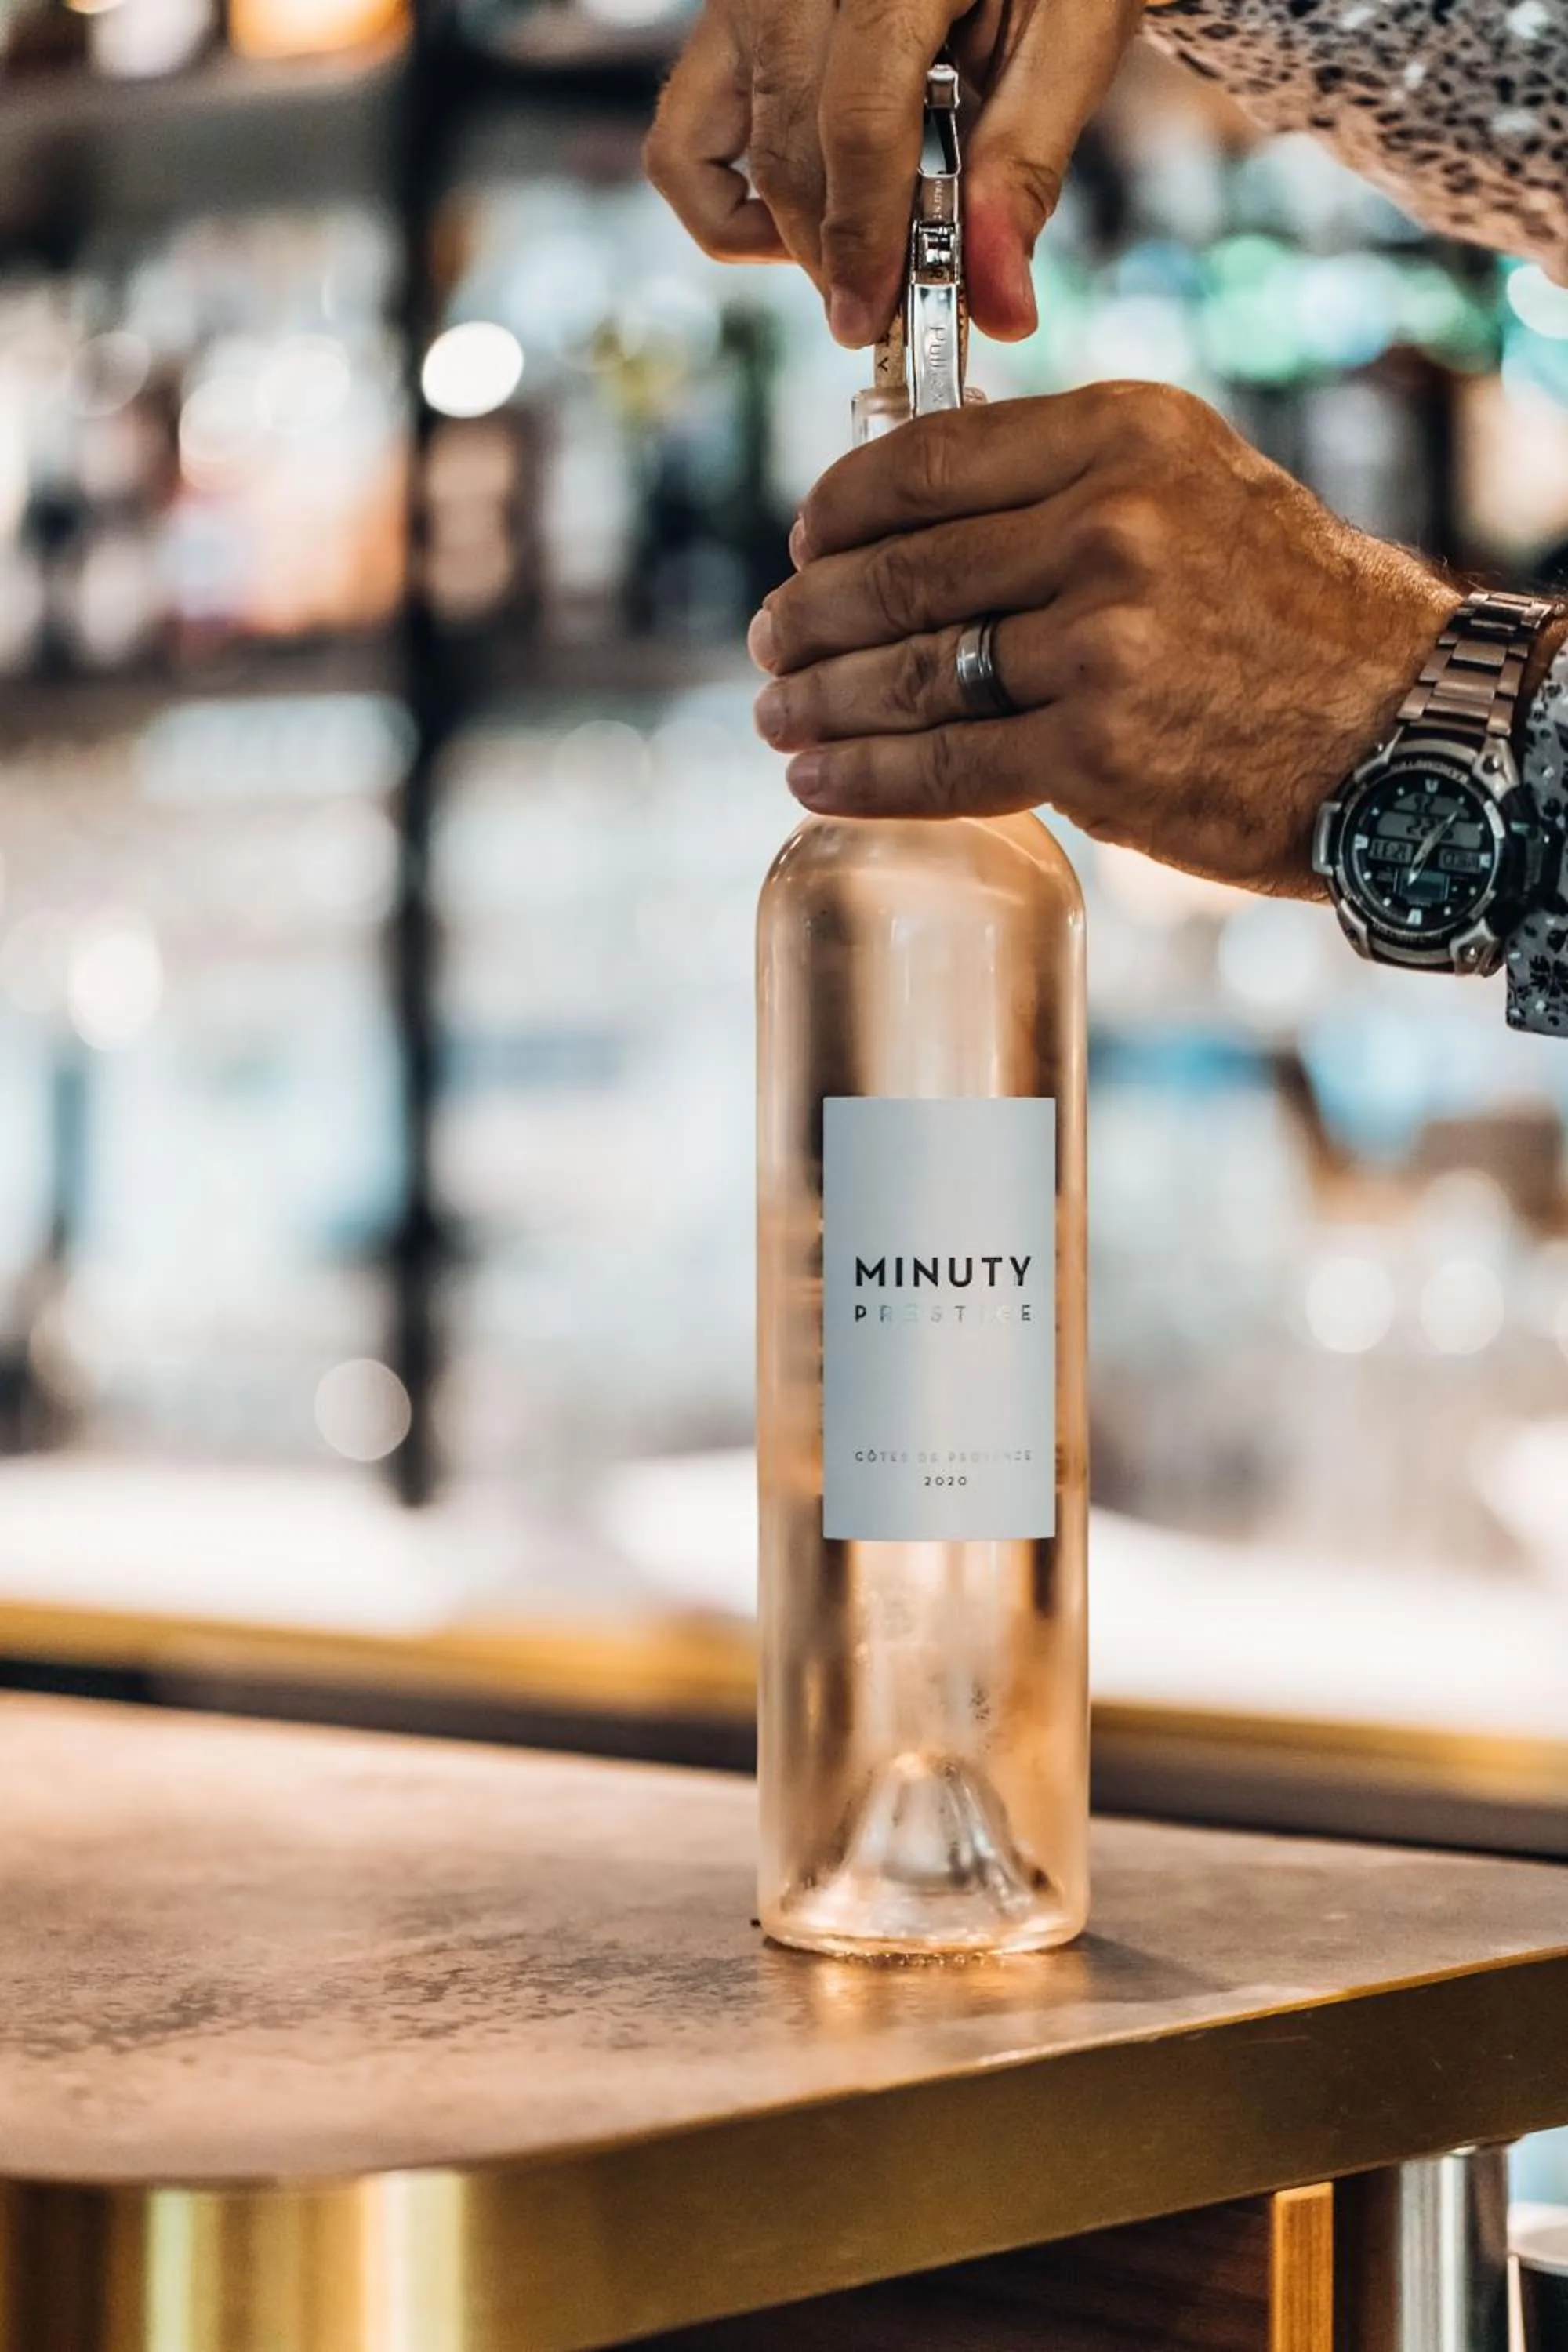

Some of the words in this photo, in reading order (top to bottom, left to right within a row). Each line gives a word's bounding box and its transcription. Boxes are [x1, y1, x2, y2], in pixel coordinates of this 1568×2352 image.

[855, 1256, 1032, 1287] MINUTY
[947, 1450, 1032, 1463] PROCE
[924, 1475, 967, 1486] 2020
